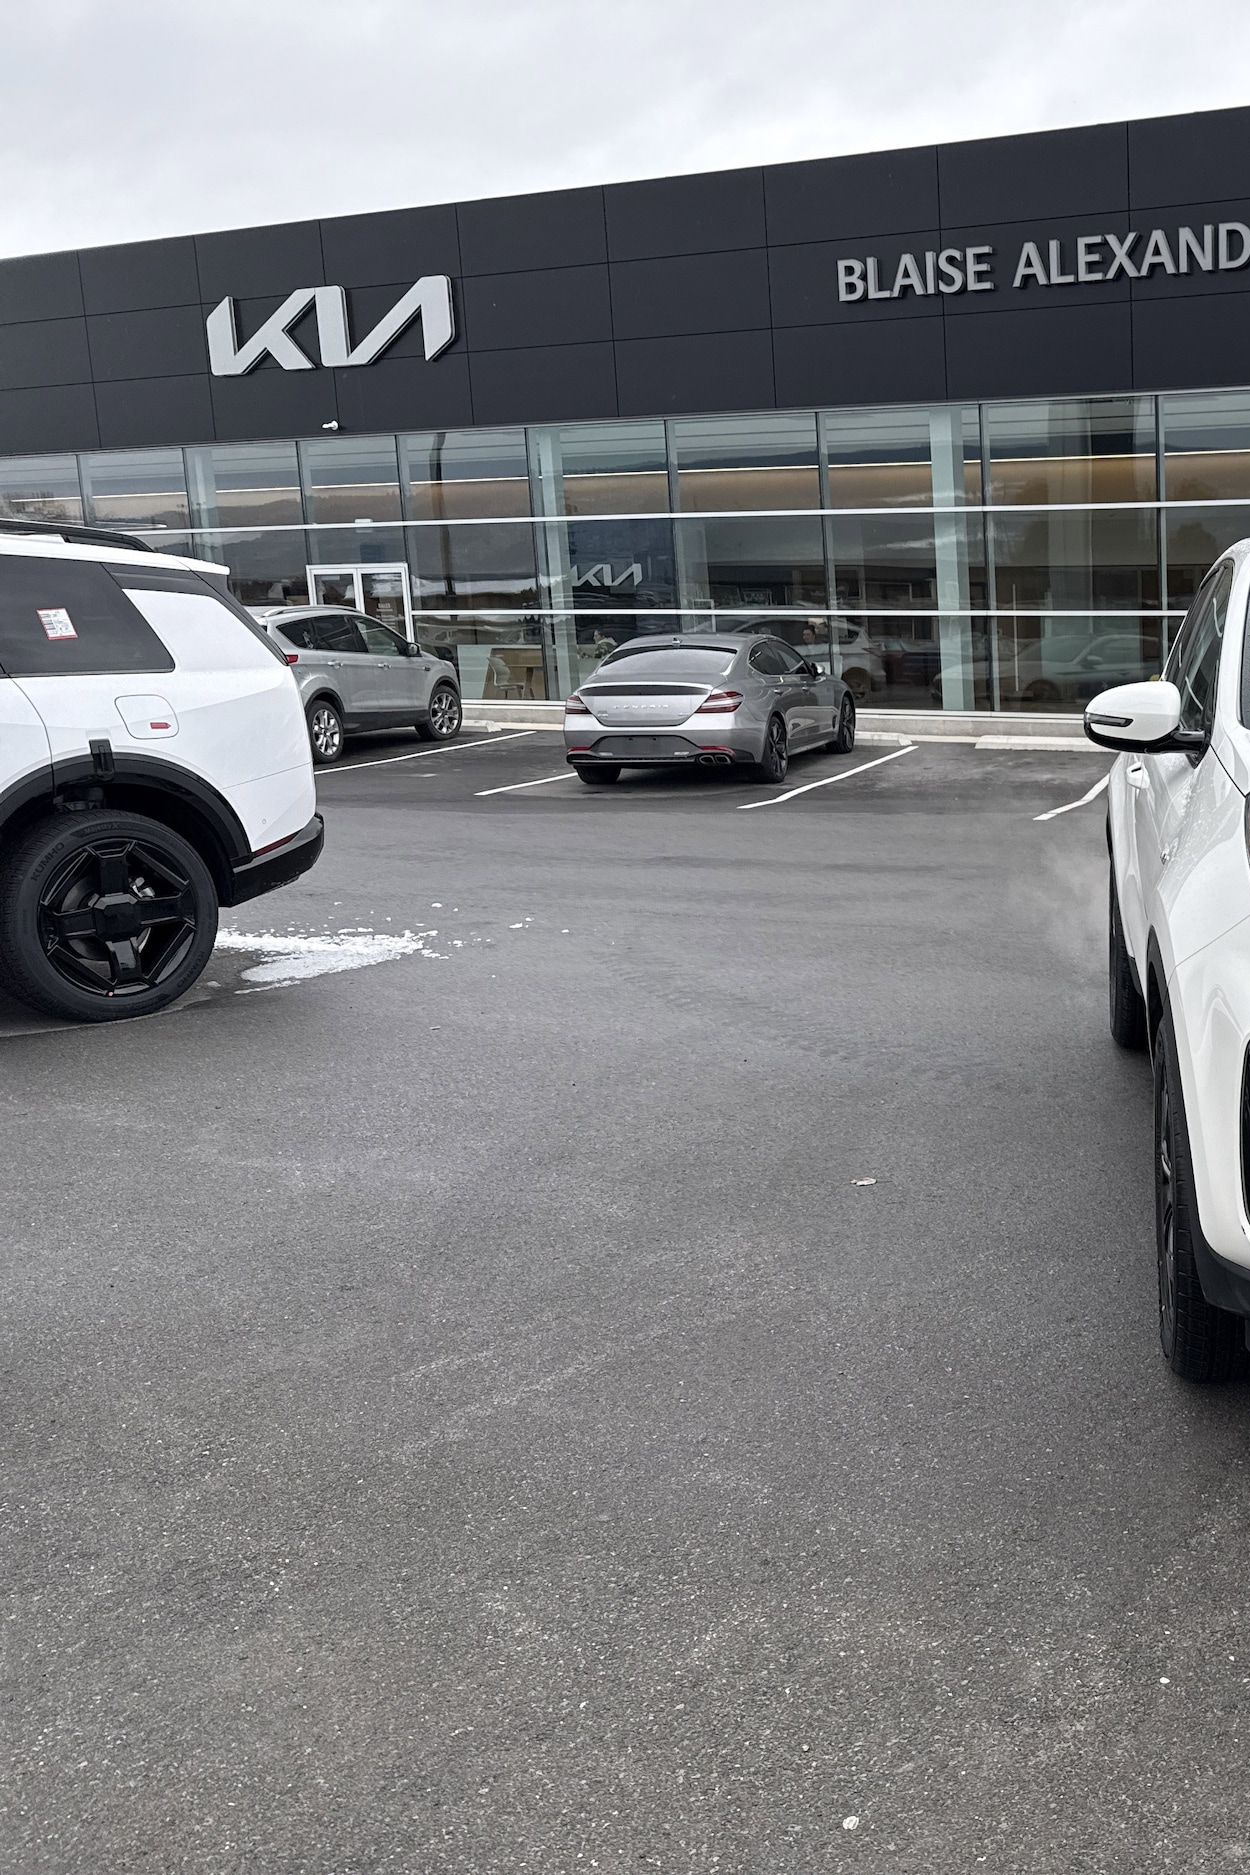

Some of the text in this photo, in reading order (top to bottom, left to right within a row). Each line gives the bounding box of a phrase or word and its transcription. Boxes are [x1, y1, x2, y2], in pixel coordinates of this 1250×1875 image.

[836, 245, 994, 301] BLAISE
[206, 274, 455, 376] KIA
[570, 563, 642, 586] KIA
[31, 842, 65, 881] KUMHO
